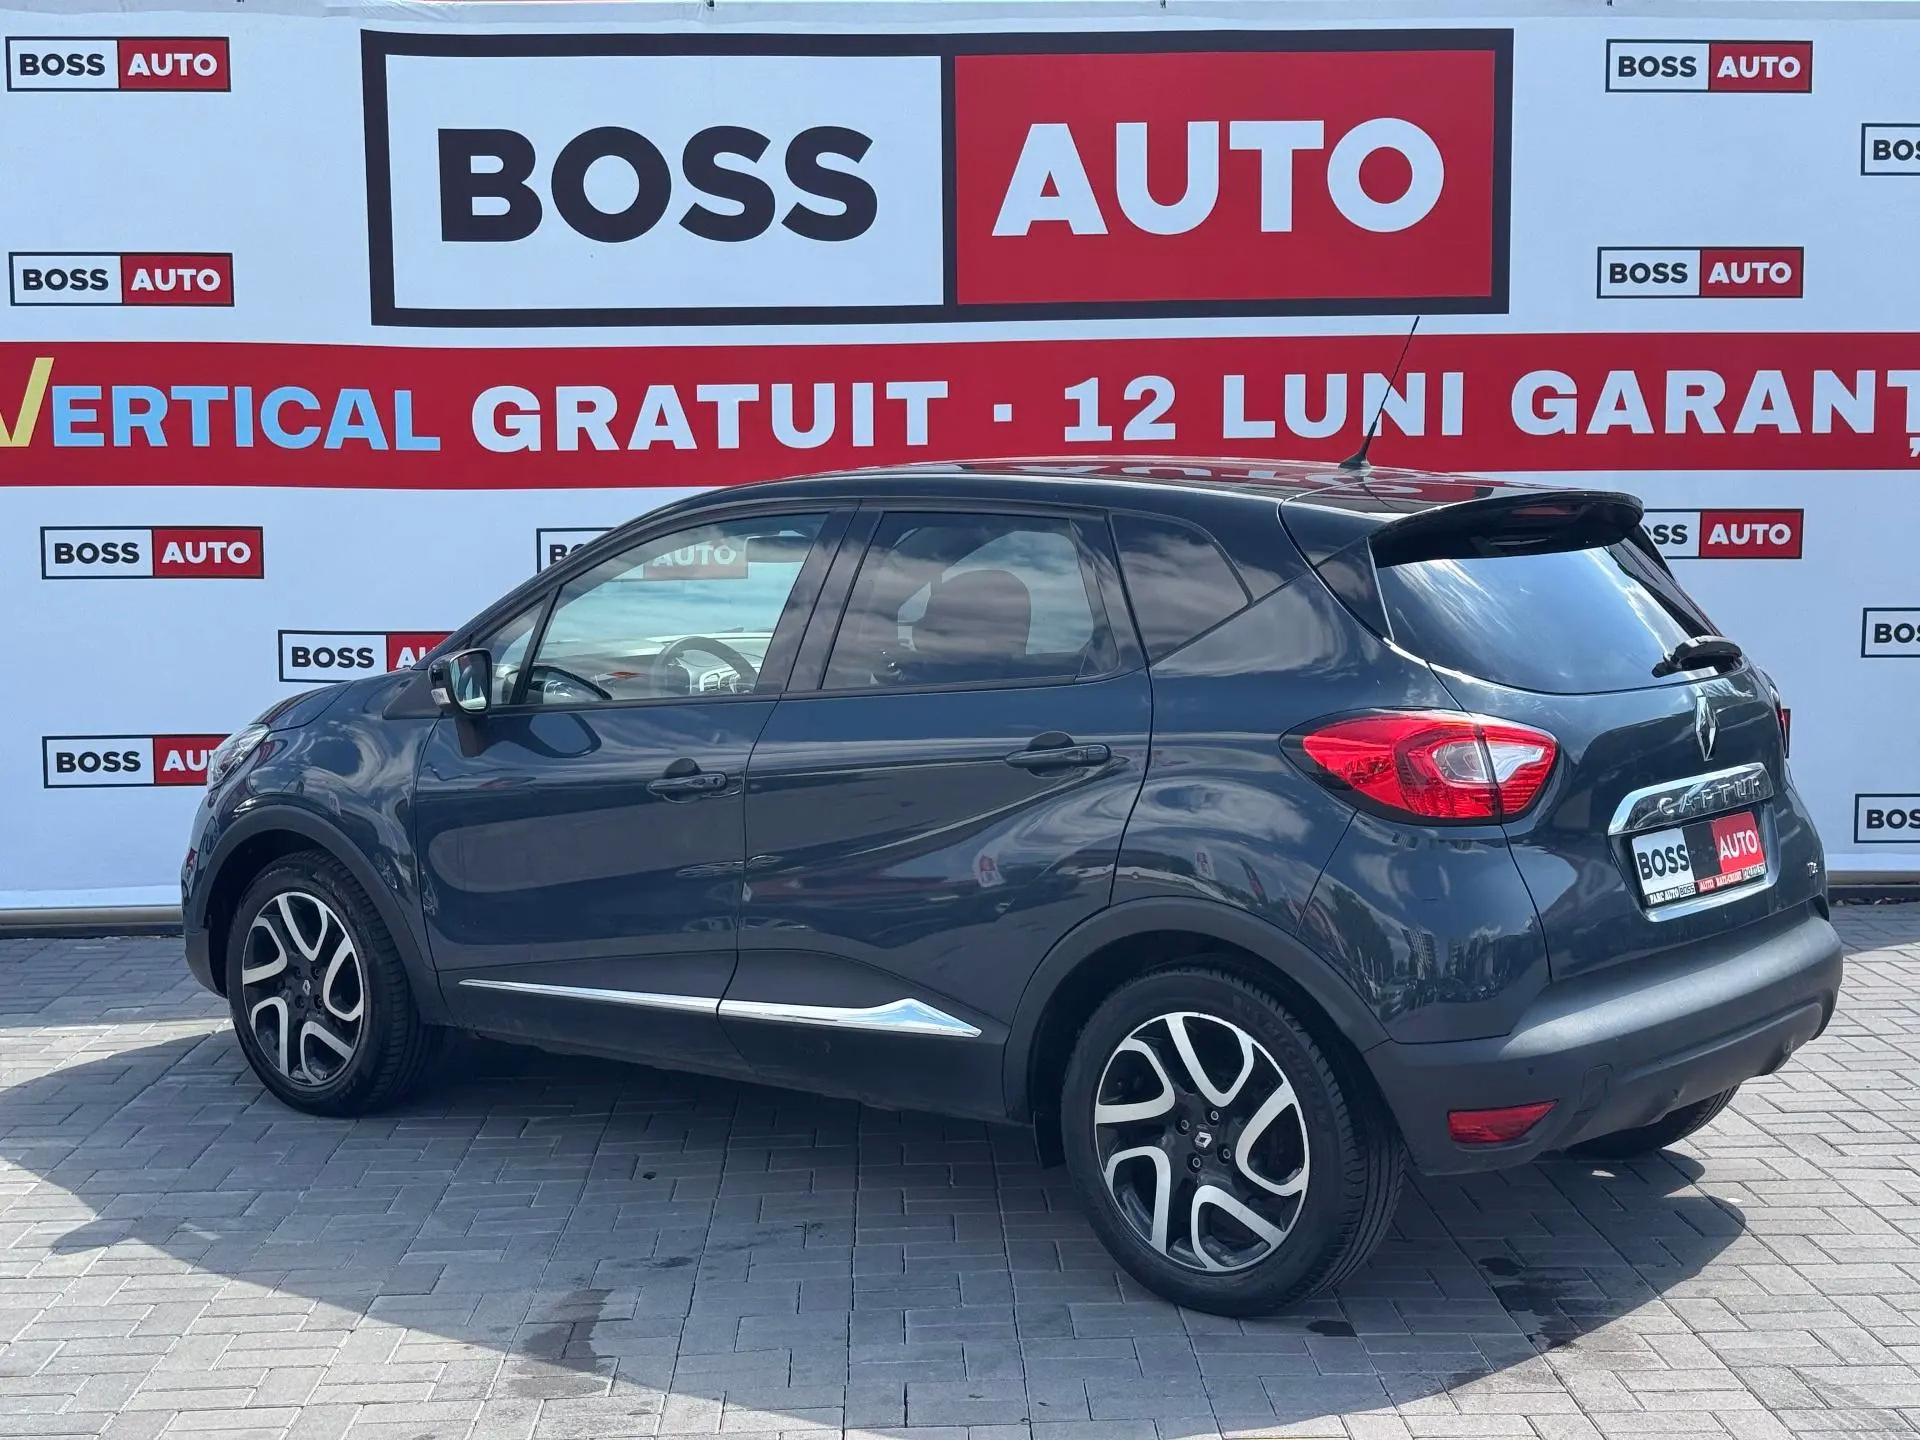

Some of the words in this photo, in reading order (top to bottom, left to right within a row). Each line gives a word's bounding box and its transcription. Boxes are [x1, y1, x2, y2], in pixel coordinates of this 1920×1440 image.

[20, 54, 105, 76] BOSS
[128, 53, 217, 76] AUTO
[1618, 56, 1697, 77] BOSS
[1717, 56, 1800, 78] AUTO
[438, 126, 877, 242] BOSS
[992, 118, 1444, 236] AUTO
[23, 269, 108, 291] BOSS
[131, 269, 220, 291] AUTO
[1609, 263, 1687, 283] BOSS
[1708, 262, 1791, 283] AUTO
[0, 357, 440, 451] VERTICAL
[472, 381, 948, 452] GRATUIT
[1064, 376, 1175, 441] 12
[1223, 372, 1463, 438] LUNI
[1650, 524, 1688, 545] SS
[1708, 524, 1791, 544] AUTO
[55, 543, 139, 564] BOSS
[162, 542, 251, 563] AUTO
[653, 545, 736, 567] AUTO
[1874, 623, 1920, 644] BO
[292, 647, 375, 668] BOSS
[56, 751, 141, 772] BOSS
[163, 750, 216, 772] AU
[1637, 844, 1690, 880] BOSS
[1719, 830, 1758, 861] AUTO
